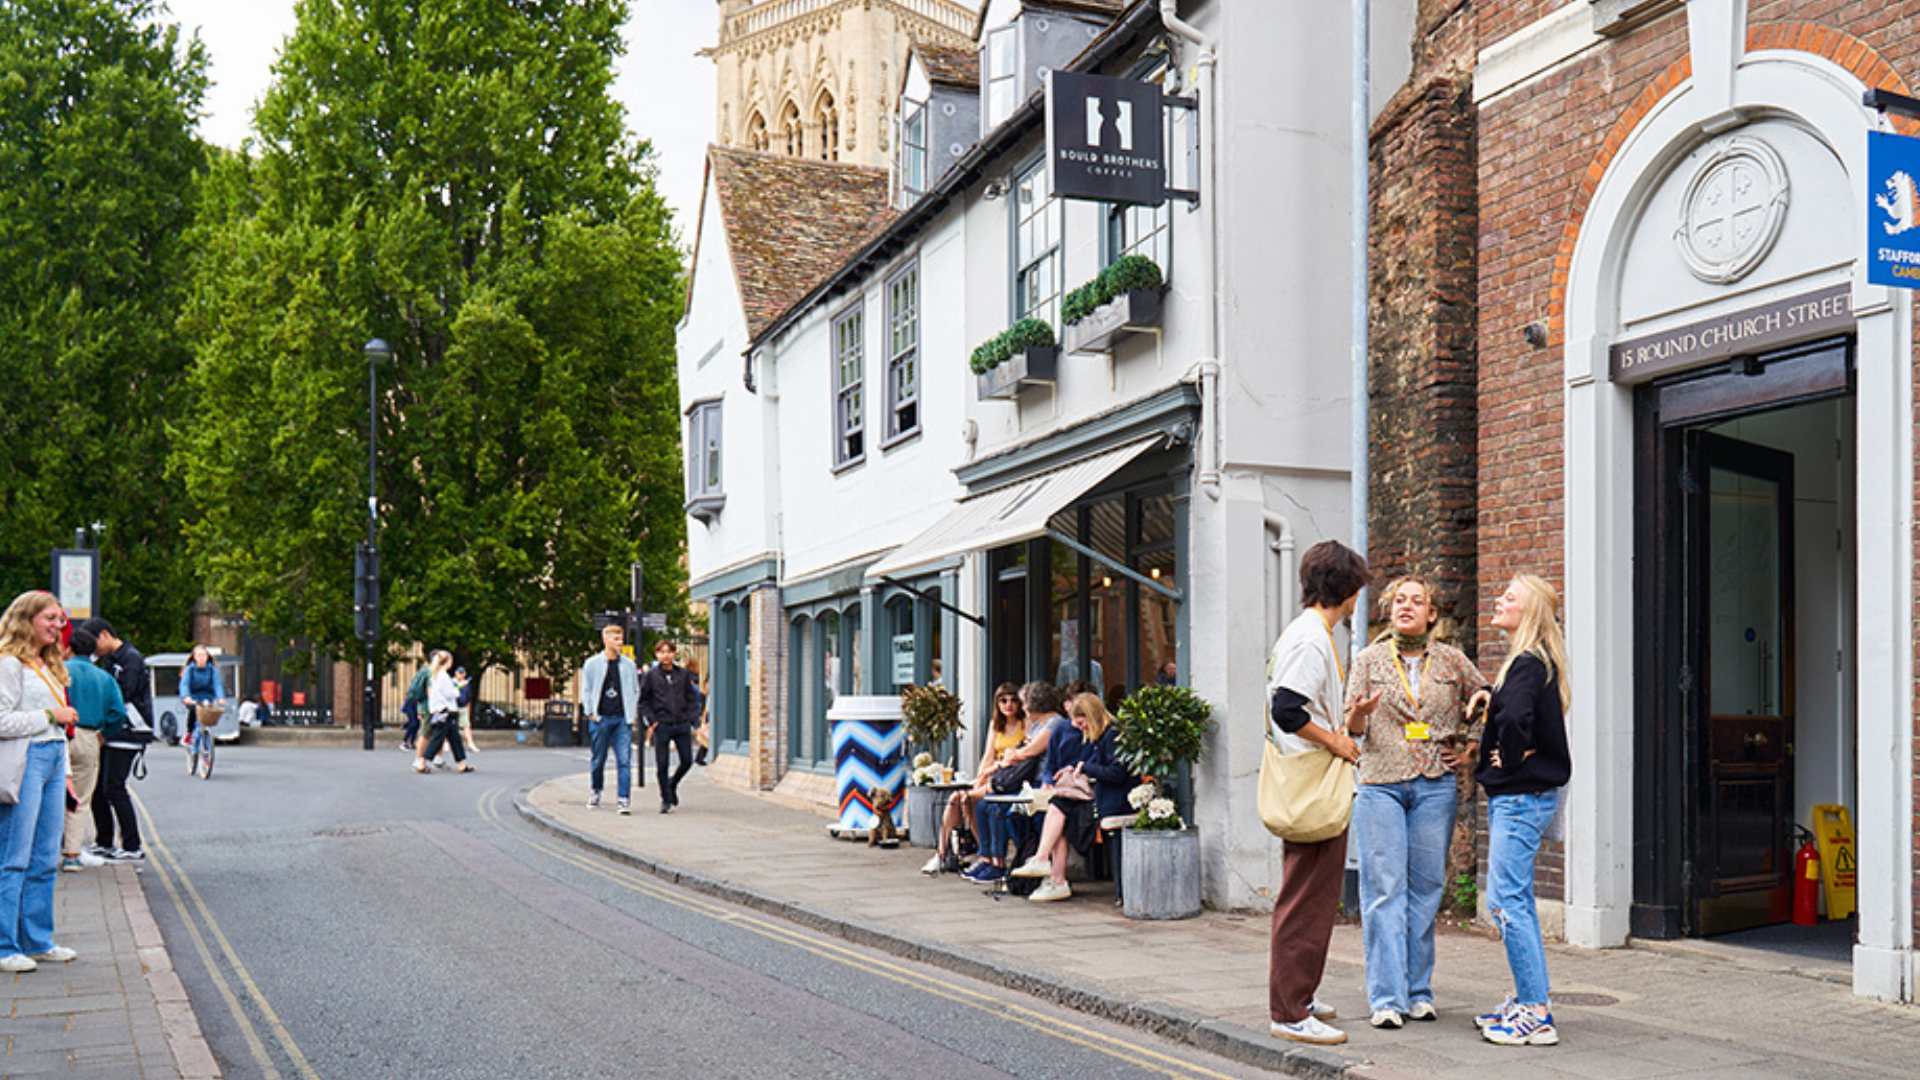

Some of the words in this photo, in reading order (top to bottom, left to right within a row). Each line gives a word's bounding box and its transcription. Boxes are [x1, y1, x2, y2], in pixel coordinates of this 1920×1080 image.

[1060, 149, 1098, 162] BOULD
[1103, 153, 1159, 169] BROTHERS
[1087, 165, 1133, 179] COFFEE
[1621, 349, 1634, 369] 15
[1636, 333, 1697, 364] ROUND
[1700, 313, 1781, 349] CHURCH
[1786, 293, 1852, 328] STREET
